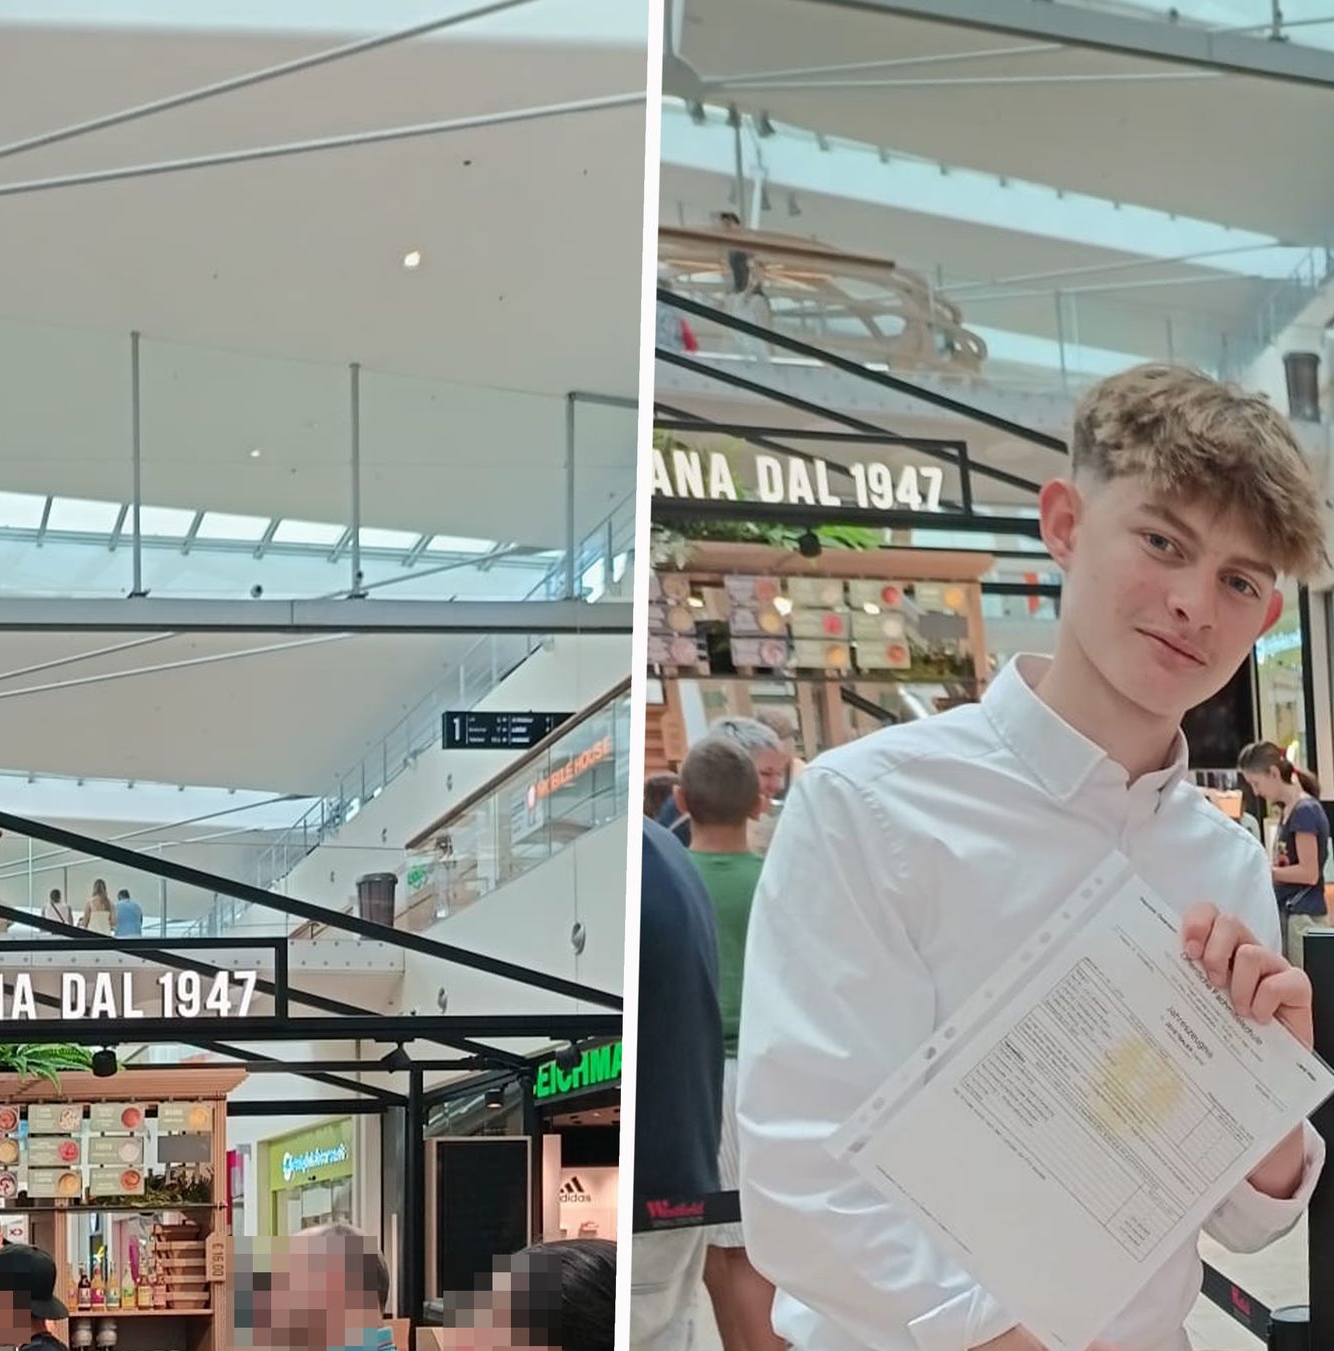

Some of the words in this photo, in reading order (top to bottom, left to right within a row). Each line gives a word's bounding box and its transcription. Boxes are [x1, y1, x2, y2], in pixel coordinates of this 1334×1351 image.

[755, 455, 841, 507] DAL
[849, 461, 943, 512] 1947
[453, 717, 460, 741] 1
[61, 972, 146, 1019] DAL
[158, 970, 258, 1018] 1947
